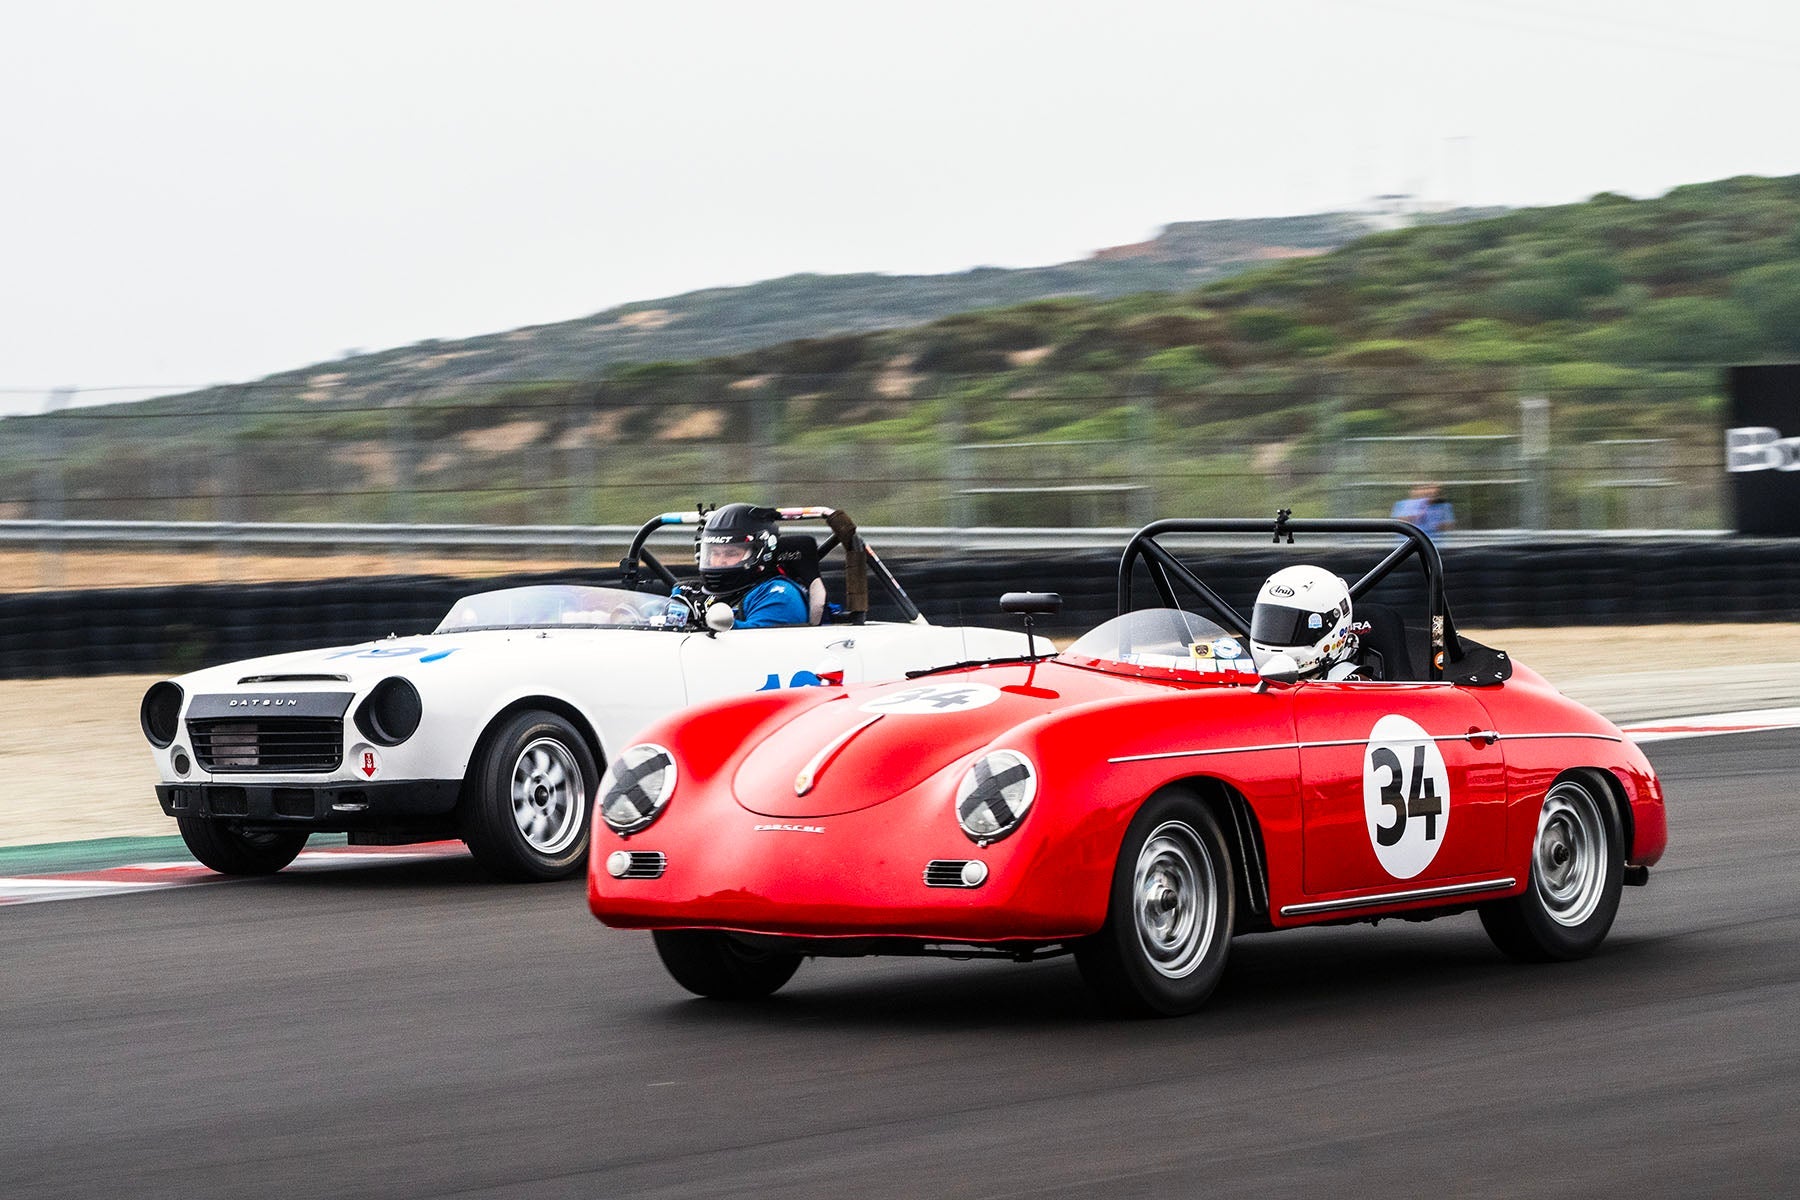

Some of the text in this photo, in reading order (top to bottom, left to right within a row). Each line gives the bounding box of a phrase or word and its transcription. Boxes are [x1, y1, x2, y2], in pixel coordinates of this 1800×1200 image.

[229, 699, 297, 707] DATSUN
[869, 687, 979, 709] 34
[1371, 745, 1442, 847] 34
[754, 824, 826, 834] PORSCHE
